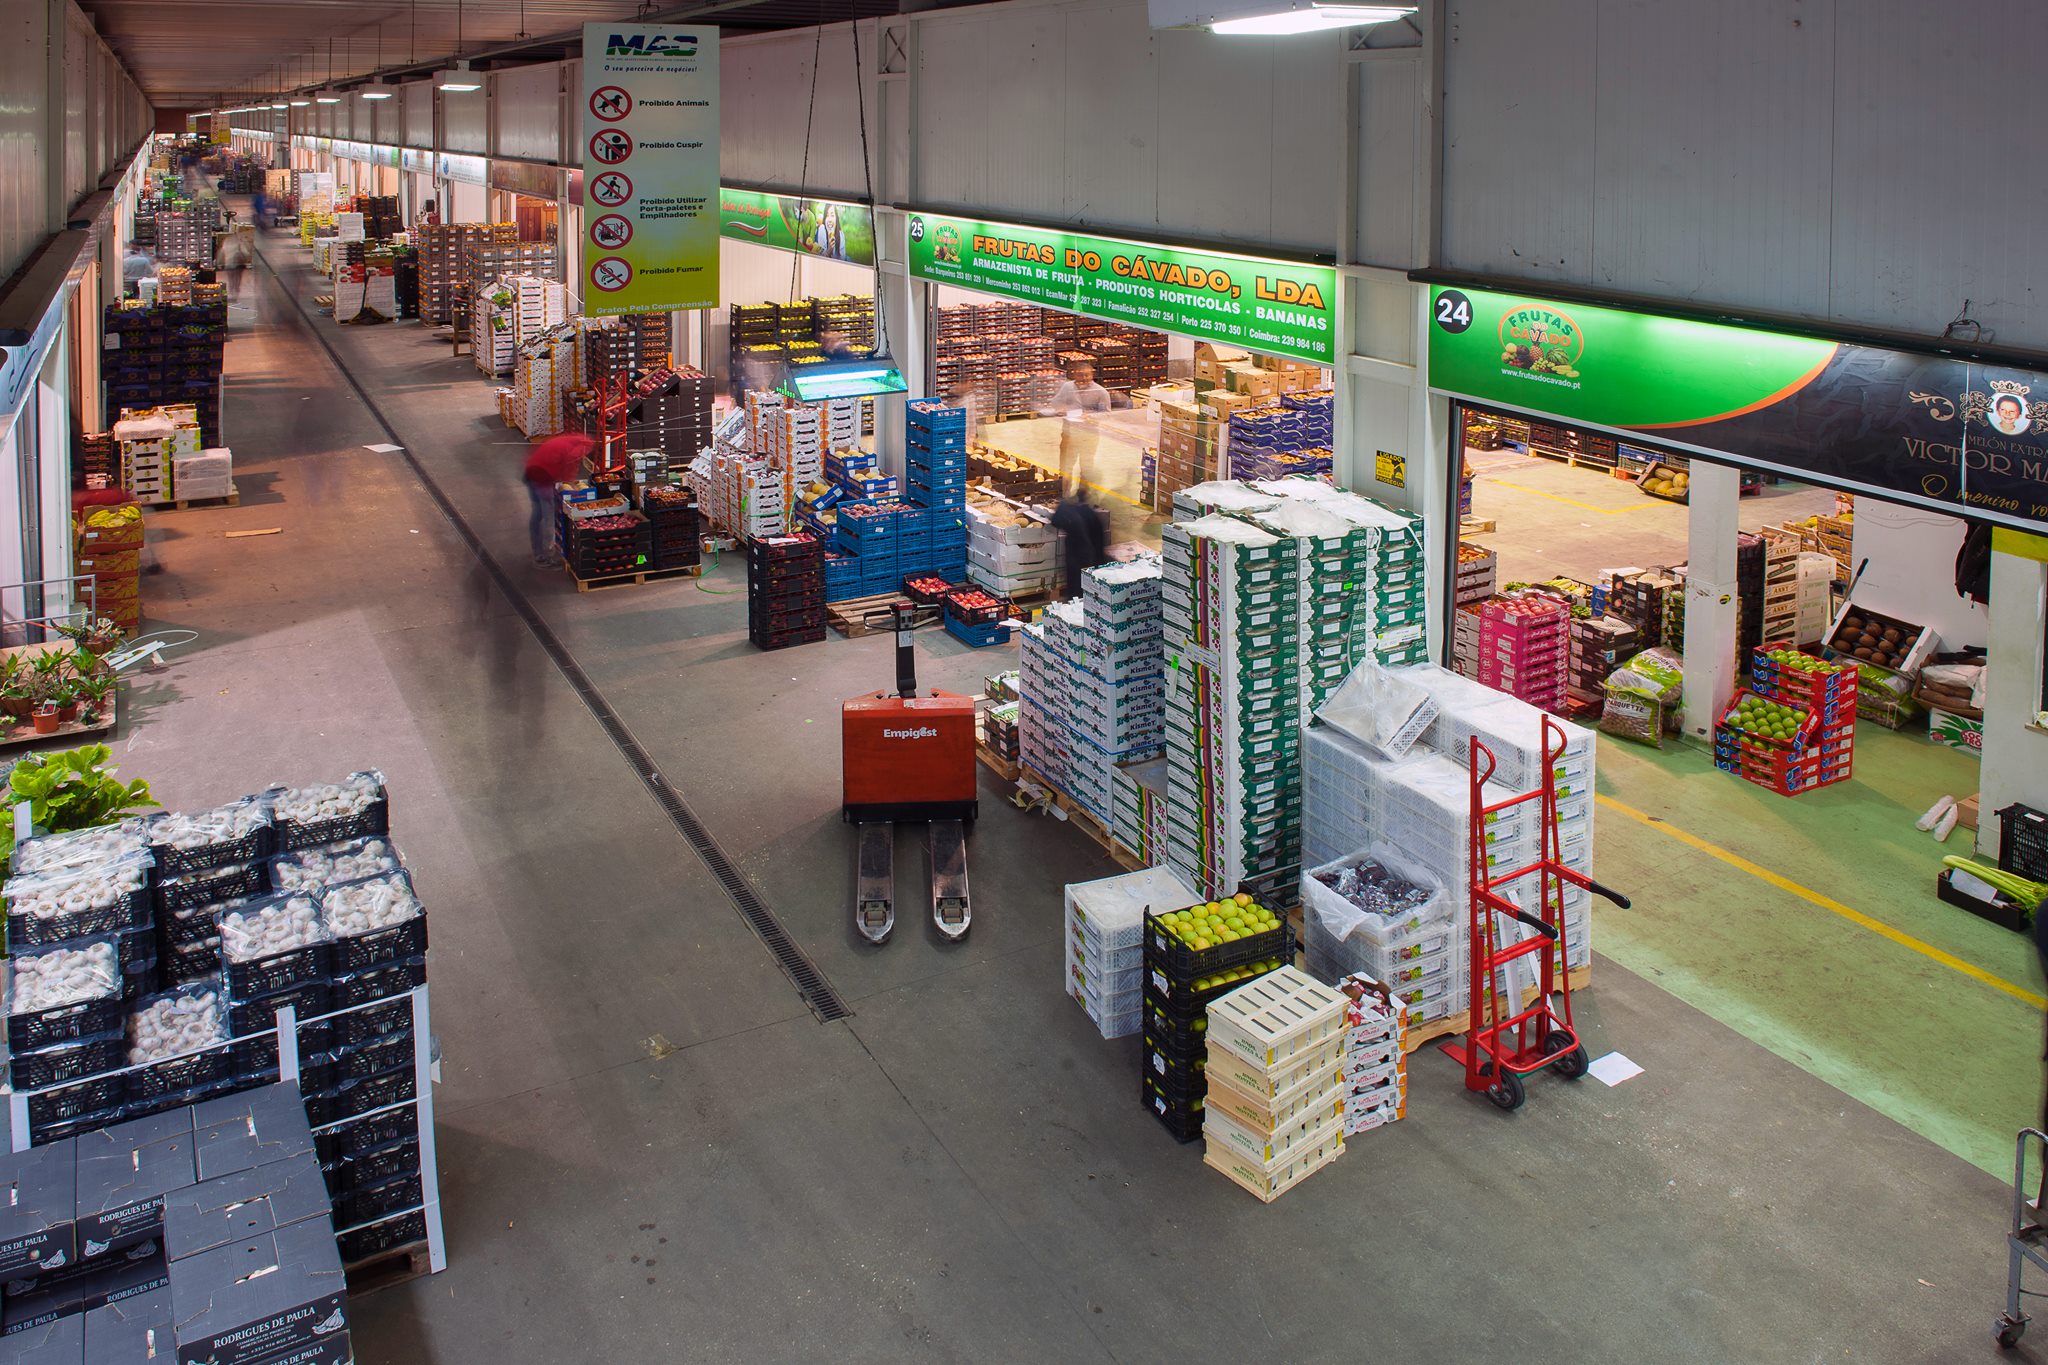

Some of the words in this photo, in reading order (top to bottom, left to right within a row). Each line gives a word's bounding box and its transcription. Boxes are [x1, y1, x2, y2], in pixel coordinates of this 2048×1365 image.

[625, 65, 654, 73] parceiro
[640, 212, 697, 220] Empilhadores
[911, 221, 924, 238] 25
[972, 234, 1056, 265] FRUTAS
[1064, 248, 1102, 272] DO
[1110, 254, 1242, 300] CÁVADO,
[1255, 275, 1327, 311] LDA
[972, 257, 1033, 277] ARMAZENISTA
[1035, 268, 1049, 280] DE
[1051, 271, 1085, 286] FRUTA
[1095, 278, 1155, 299] PRODUTOS
[1159, 290, 1241, 315] HORTICOLAS
[1255, 306, 1327, 331] BANANAS
[596, 306, 627, 315] Gratos
[651, 299, 713, 311] Compreensão
[1437, 298, 1470, 326] 24
[1108, 300, 1136, 314] Famalicão
[1137, 307, 1149, 317] 252
[1149, 309, 1161, 319] 327
[1181, 315, 1199, 327] Porto
[1200, 319, 1212, 330] 225
[1214, 321, 1227, 333] 370
[1228, 324, 1241, 336] 350
[1249, 328, 1281, 344] Coimbra:
[1281, 335, 1296, 346] 239
[1296, 338, 1310, 350] 984
[1311, 341, 1326, 353] 186
[1507, 309, 1574, 336] FRUTAS
[1533, 321, 1549, 332] DO
[1510, 325, 1572, 347] CÁVADO
[1500, 367, 1581, 390] www.frutasdocavado.pt
[1968, 434, 2007, 451] MELÓN
[1902, 436, 2013, 477] VICTOR
[1921, 473, 1948, 496] O
[1955, 489, 2020, 511] menino
[883, 726, 938, 739] Empigest
[99, 1204, 141, 1224] RODRIGUES
[142, 1201, 152, 1211] DE
[13, 1240, 24, 1250] DE
[24, 1234, 48, 1247] PAULA
[107, 1283, 148, 1303] RODRIGUES
[149, 1280, 159, 1290] DE
[23, 1320, 35, 1329] DE
[35, 1312, 58, 1326] PAULA
[213, 1321, 271, 1349] RODRIGUES
[271, 1317, 285, 1329] DE
[286, 1306, 316, 1324] PAULA
[289, 1354, 300, 1365] DE
[301, 1345, 324, 1360] PAULA
